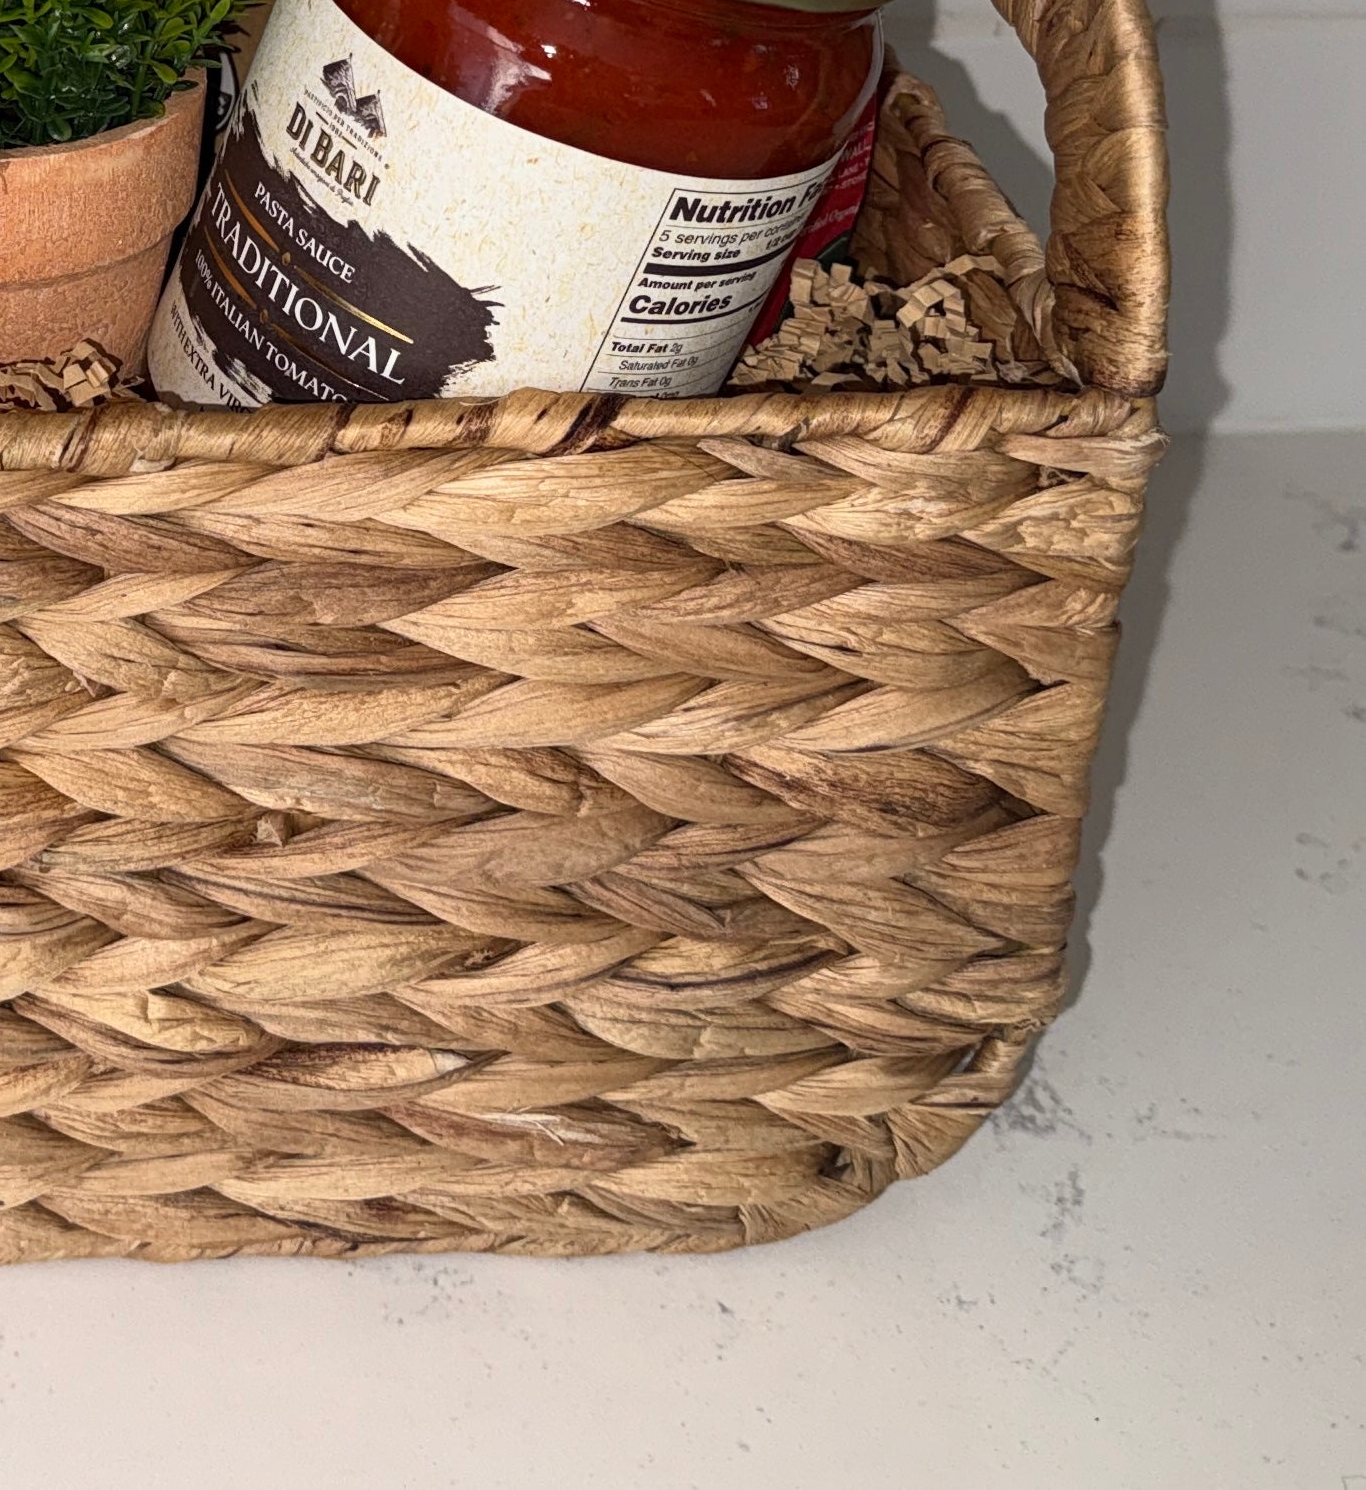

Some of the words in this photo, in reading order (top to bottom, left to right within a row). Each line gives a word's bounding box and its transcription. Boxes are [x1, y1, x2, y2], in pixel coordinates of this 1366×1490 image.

[286, 100, 314, 152] DI
[310, 127, 381, 207] BARI
[669, 194, 797, 224] Nutrition
[254, 181, 296, 239] PASTA
[295, 228, 357, 284] SAUCE
[659, 229, 671, 243] 5
[675, 231, 738, 248] servings
[739, 229, 763, 245] per
[651, 246, 711, 262] Serving
[714, 248, 741, 261] size
[210, 181, 407, 386] TRADITIONAL
[638, 277, 693, 291] Amount
[694, 279, 716, 292] per
[719, 270, 757, 287] serving
[195, 247, 215, 291] 100%
[211, 279, 266, 352] ITALIAN
[628, 294, 733, 316] Calories
[611, 341, 645, 353] Total
[647, 342, 669, 353] Fat
[669, 342, 684, 355] 2g
[184, 339, 216, 391] EXTRA
[618, 359, 671, 371] Saturated
[671, 357, 687, 370] Fat
[608, 376, 641, 389] Trans
[641, 377, 659, 388] Fat
[659, 376, 673, 389] 0g
